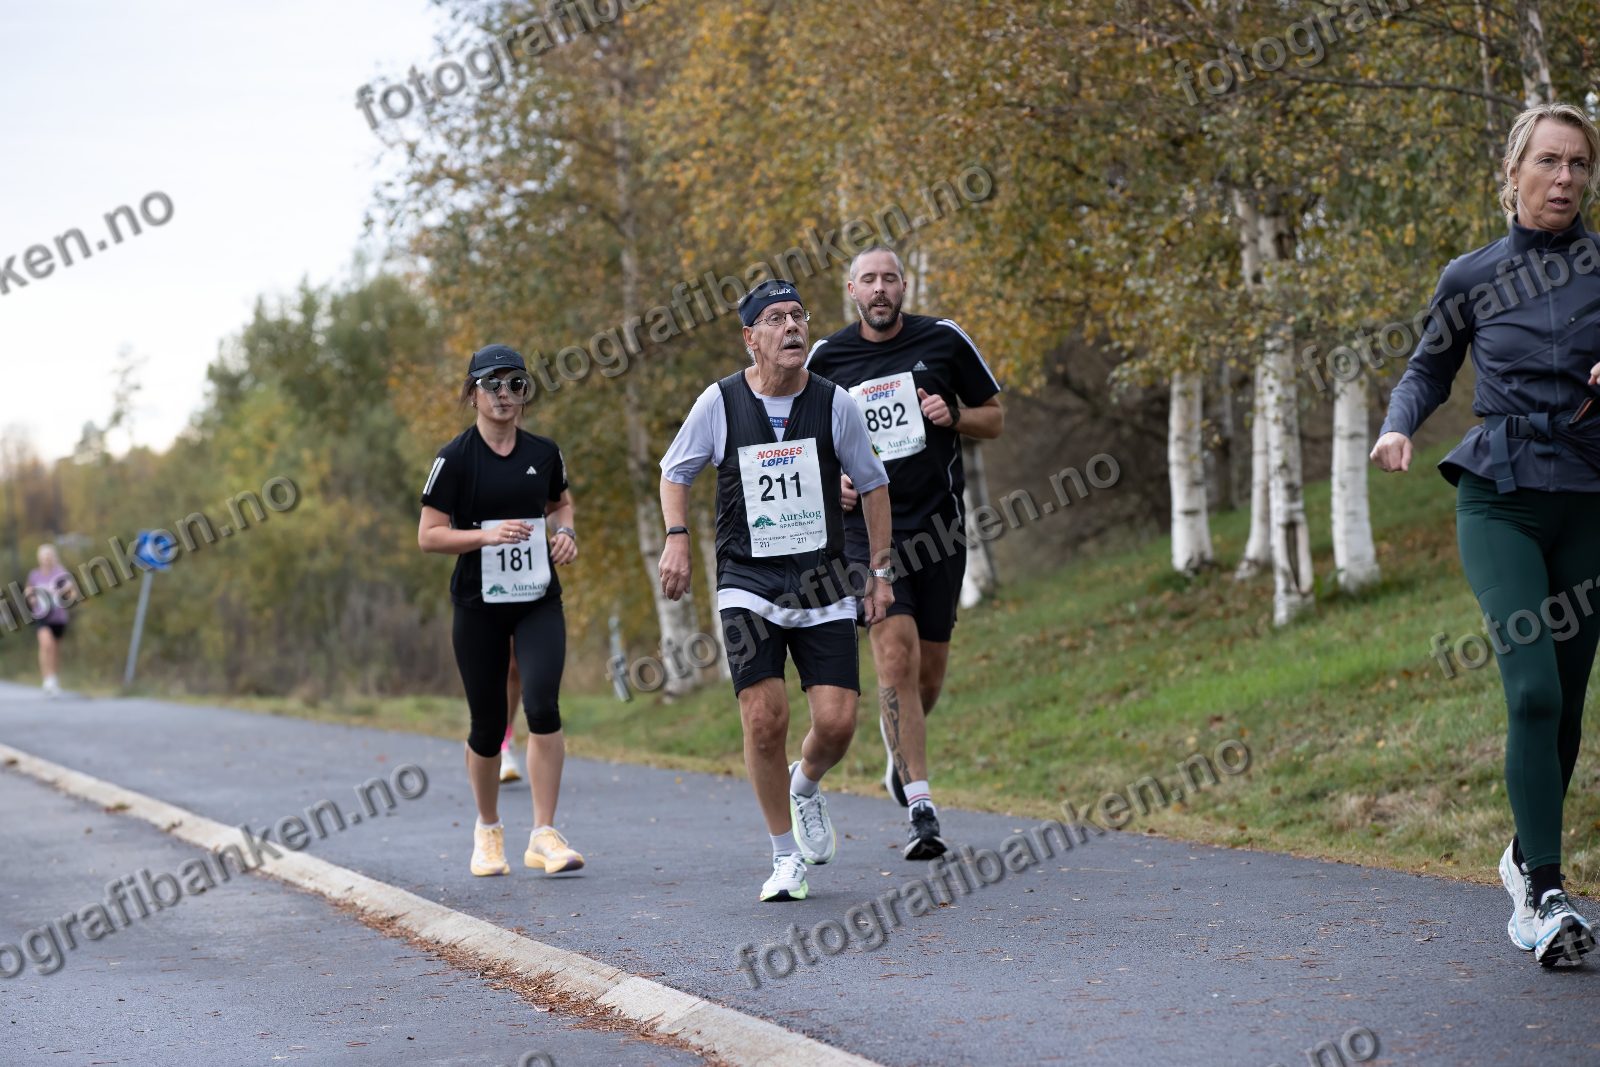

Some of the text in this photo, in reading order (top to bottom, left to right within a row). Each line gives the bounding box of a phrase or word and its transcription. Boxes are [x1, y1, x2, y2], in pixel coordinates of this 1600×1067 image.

[861, 380, 901, 395] NORGES
[867, 389, 896, 402] LØPET
[865, 402, 909, 432] 892
[757, 446, 803, 460] NORGES
[761, 456, 796, 467] LØPET
[759, 471, 802, 502] 211
[779, 510, 822, 522] Aurskog
[496, 547, 532, 572] 181
